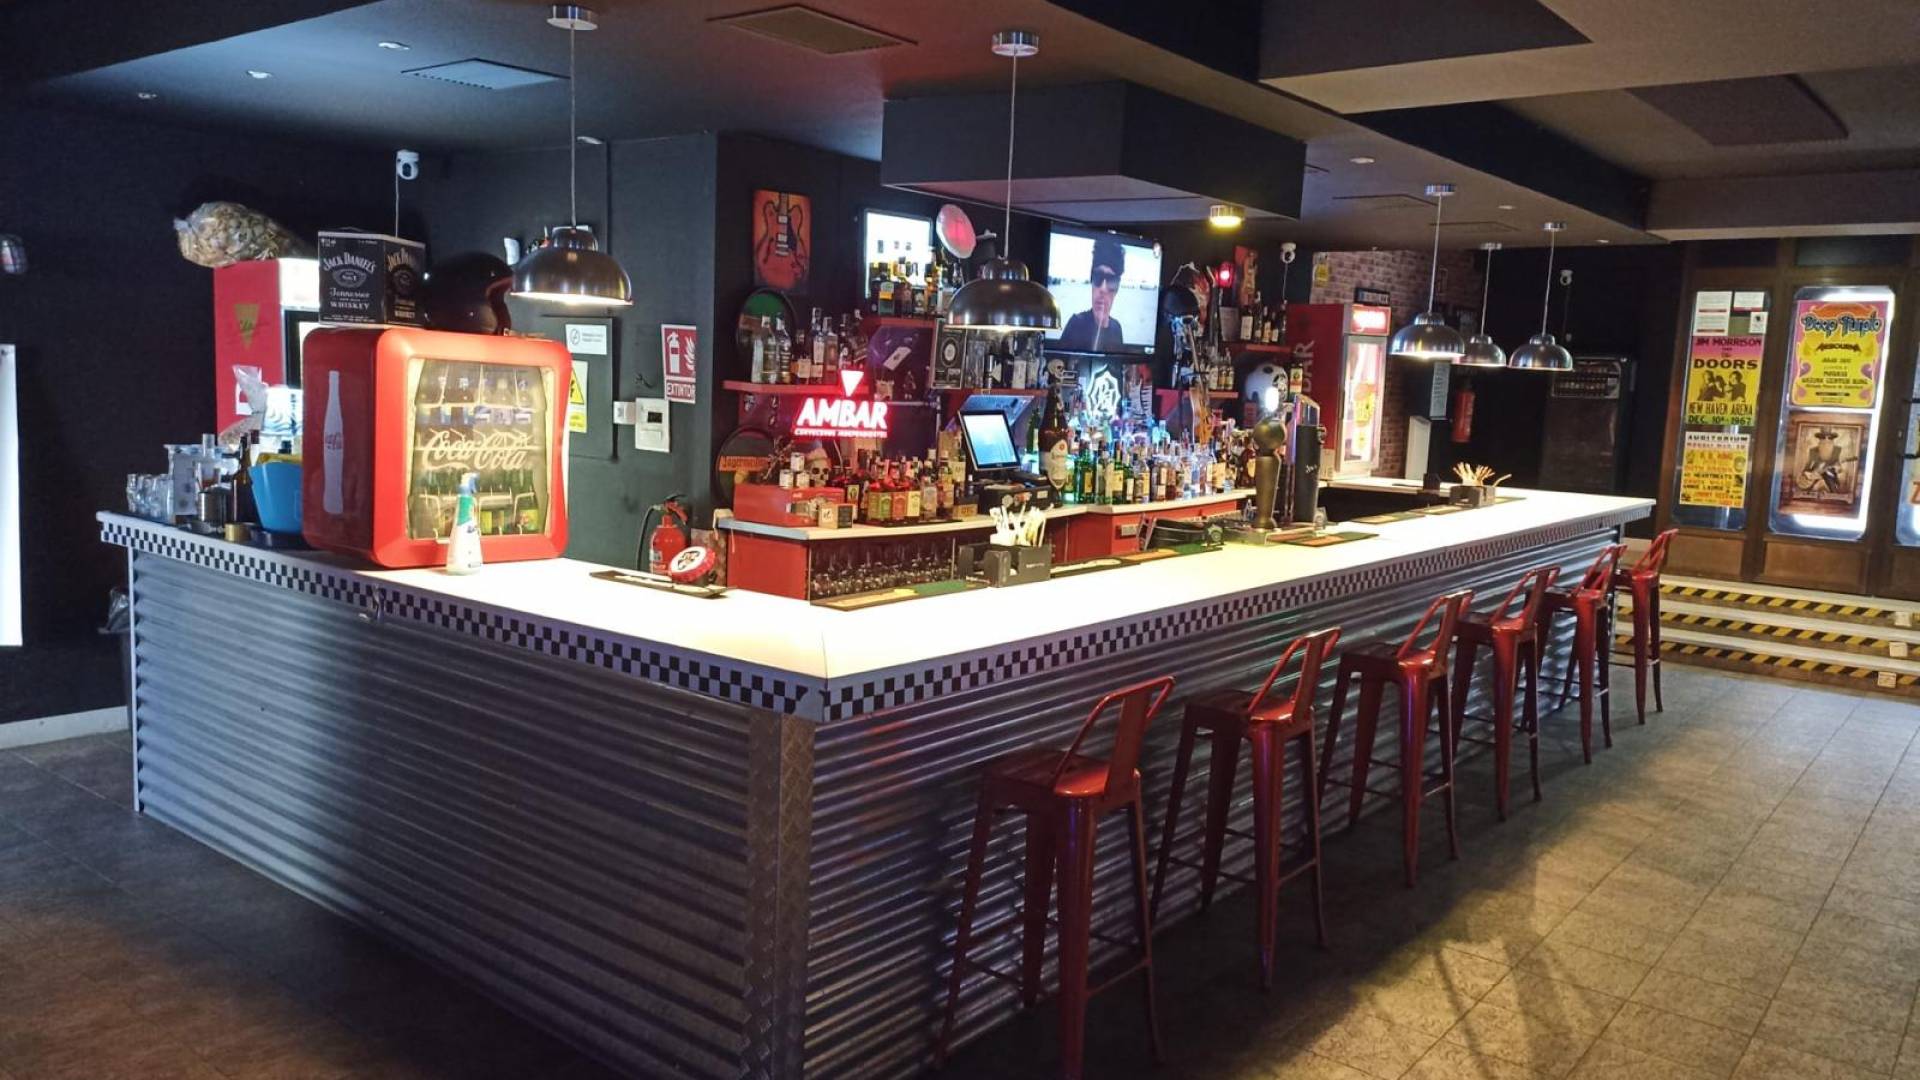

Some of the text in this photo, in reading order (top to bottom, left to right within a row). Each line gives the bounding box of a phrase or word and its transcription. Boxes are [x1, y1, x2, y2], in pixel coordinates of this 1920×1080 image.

[323, 256, 343, 271] JACK
[330, 301, 369, 310] WHISKEY
[1712, 338, 1761, 347] MORRISON
[1693, 359, 1759, 370] DOORS
[796, 397, 888, 430] AMBAR
[1688, 402, 1753, 416] NEW HAVEN ARENA
[1687, 415, 1706, 424] DEC.
[1688, 434, 1749, 442] AUDITORIUM
[422, 430, 529, 470] Coca-Cola
